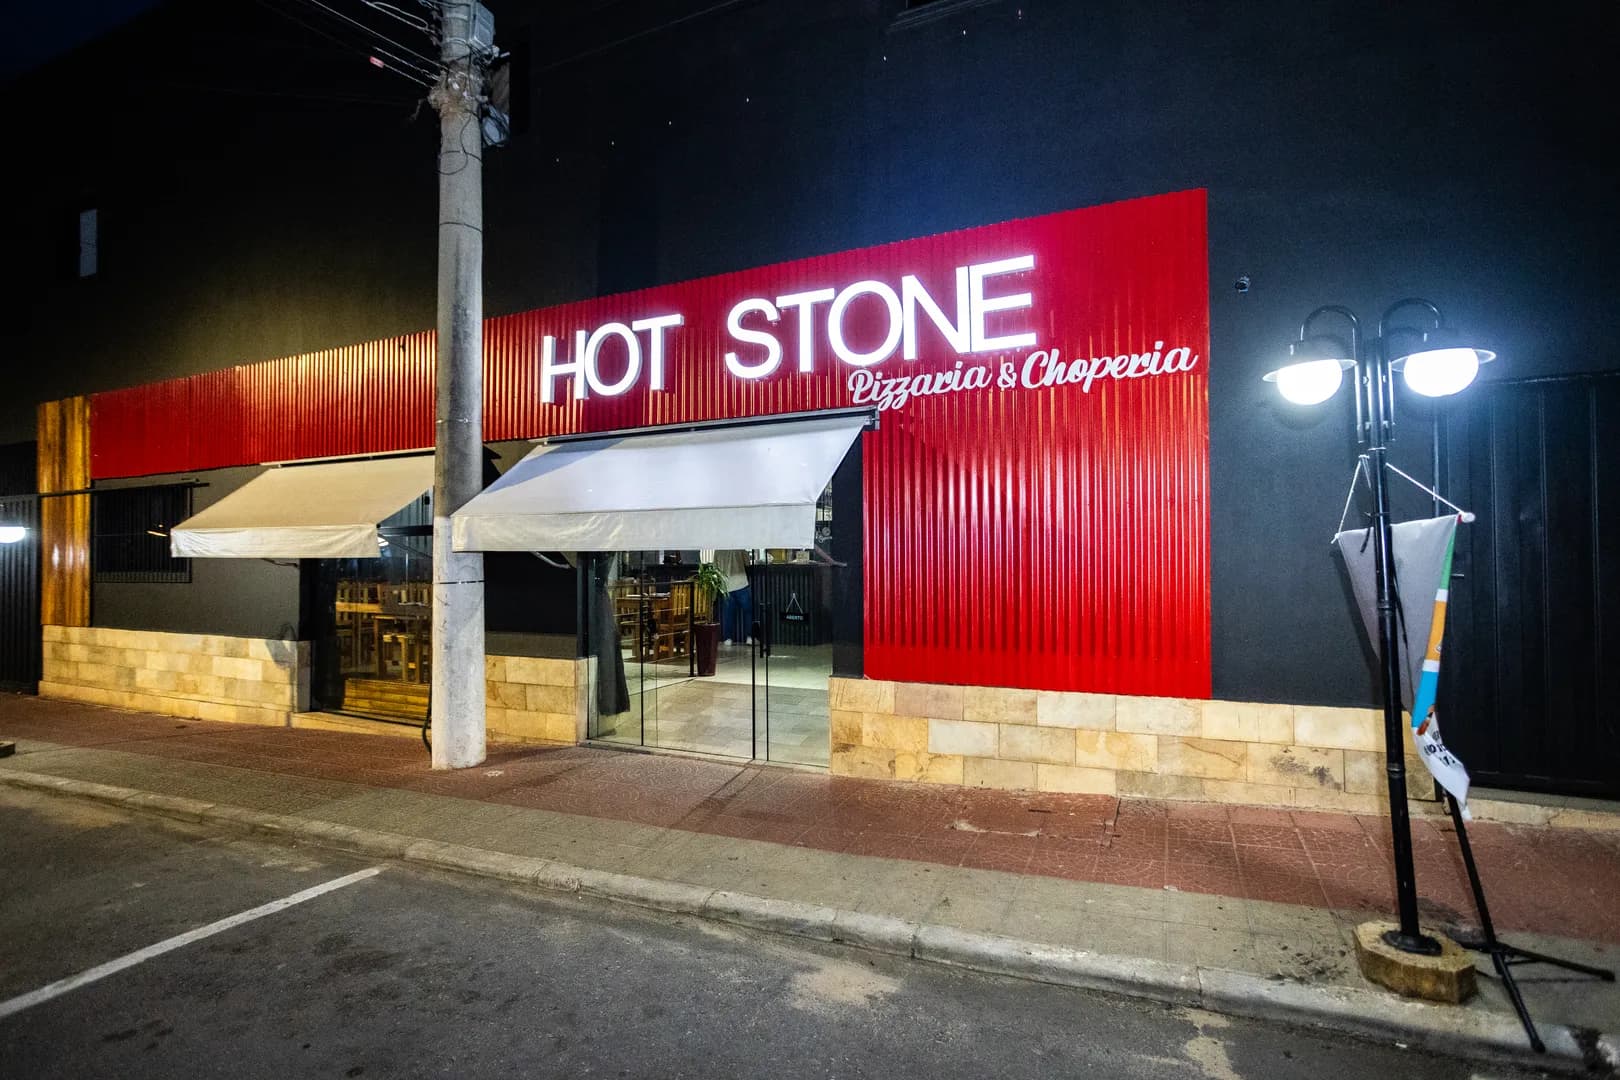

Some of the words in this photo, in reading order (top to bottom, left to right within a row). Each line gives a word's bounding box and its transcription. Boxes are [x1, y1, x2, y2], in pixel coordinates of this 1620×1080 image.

[541, 313, 684, 404] HOT
[724, 254, 1037, 380] STONE
[848, 360, 993, 411] Pizzaria
[997, 362, 1017, 391] &
[1021, 341, 1199, 393] Choperia
